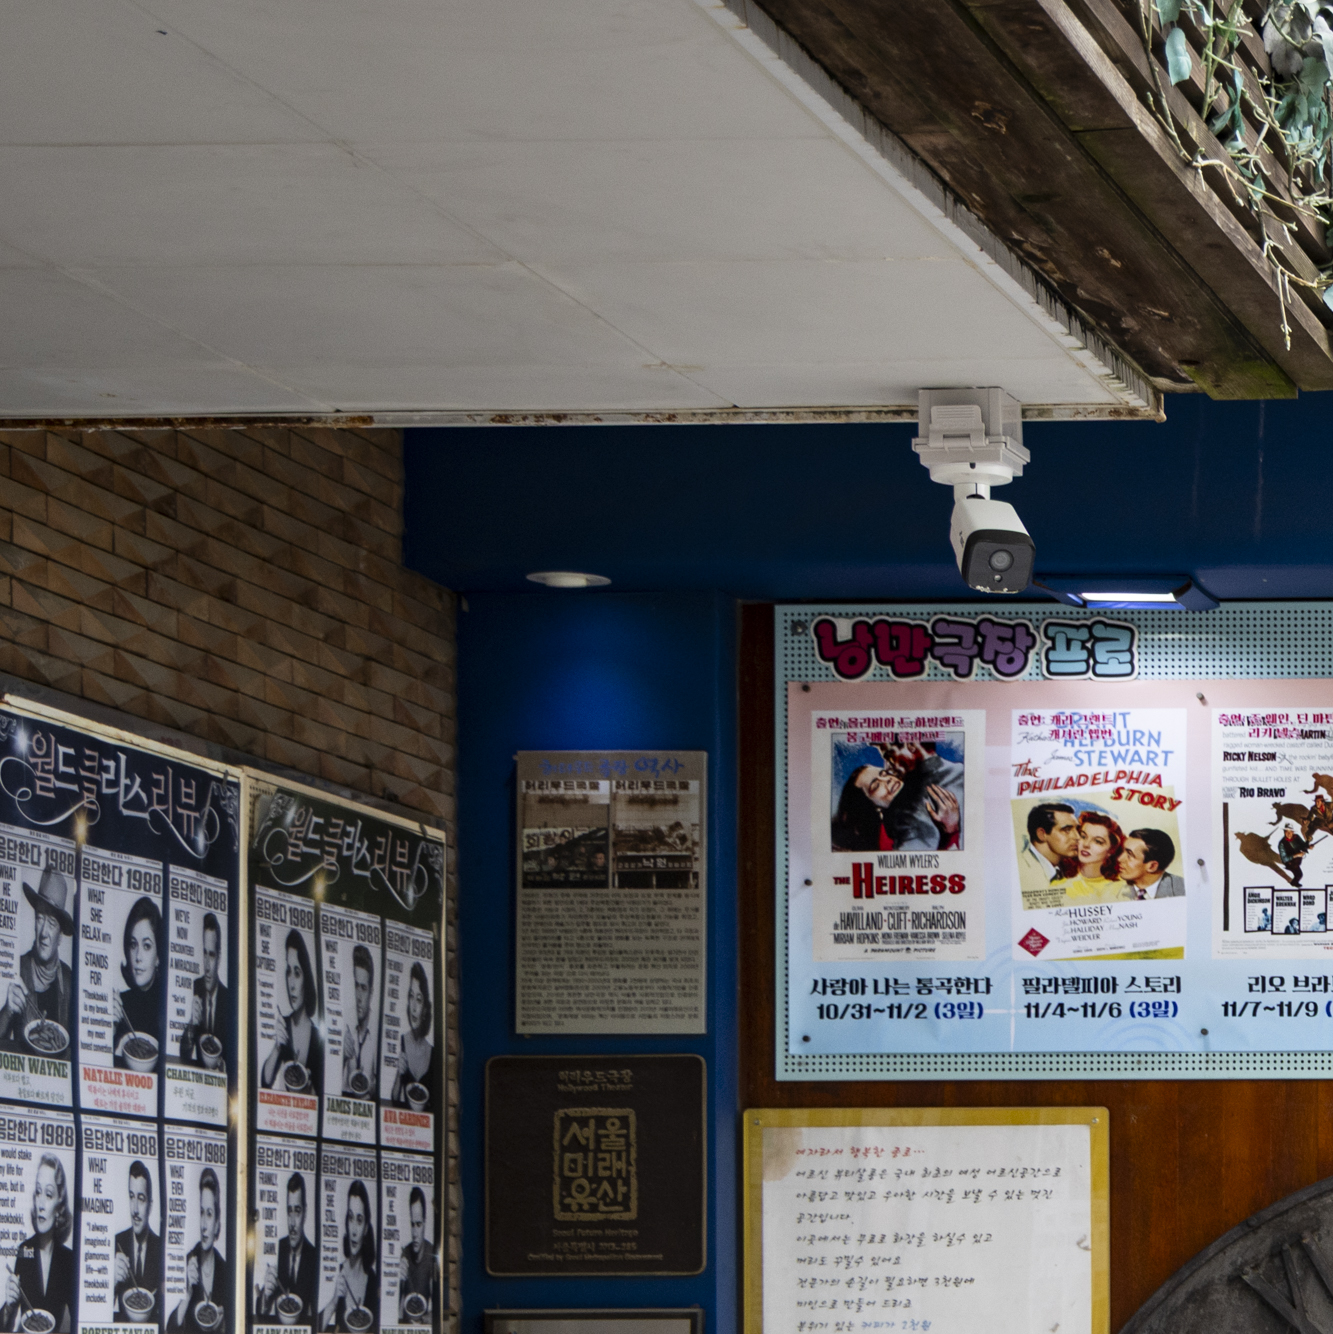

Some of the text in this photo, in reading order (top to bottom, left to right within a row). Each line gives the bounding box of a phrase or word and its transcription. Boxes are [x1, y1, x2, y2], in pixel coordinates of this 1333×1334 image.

[811, 615, 1139, 681] 낭만극장 프로
[1017, 770, 1163, 796] PHILADELPHIA
[1110, 787, 1182, 813] STORY
[82, 854, 162, 895] 응답한다 1988
[852, 862, 966, 899] HEIRESS
[810, 977, 994, 997] 사랑아 나는 통곡한다
[1021, 976, 1182, 995] 필라델피아 스토리
[1247, 975, 1287, 994] 리오
[816, 1000, 984, 1020] 10/31~11/2 (3일)
[1024, 999, 1179, 1019] 11/4~11/6 (3일)
[1221, 1000, 1318, 1018] 11/7~11/9
[83, 1067, 154, 1089] NATALIE WOOD
[562, 1117, 628, 1151] 서울
[88, 1157, 107, 1174] WHAT
[562, 1150, 627, 1178] 미래
[562, 1178, 628, 1212] 유산
